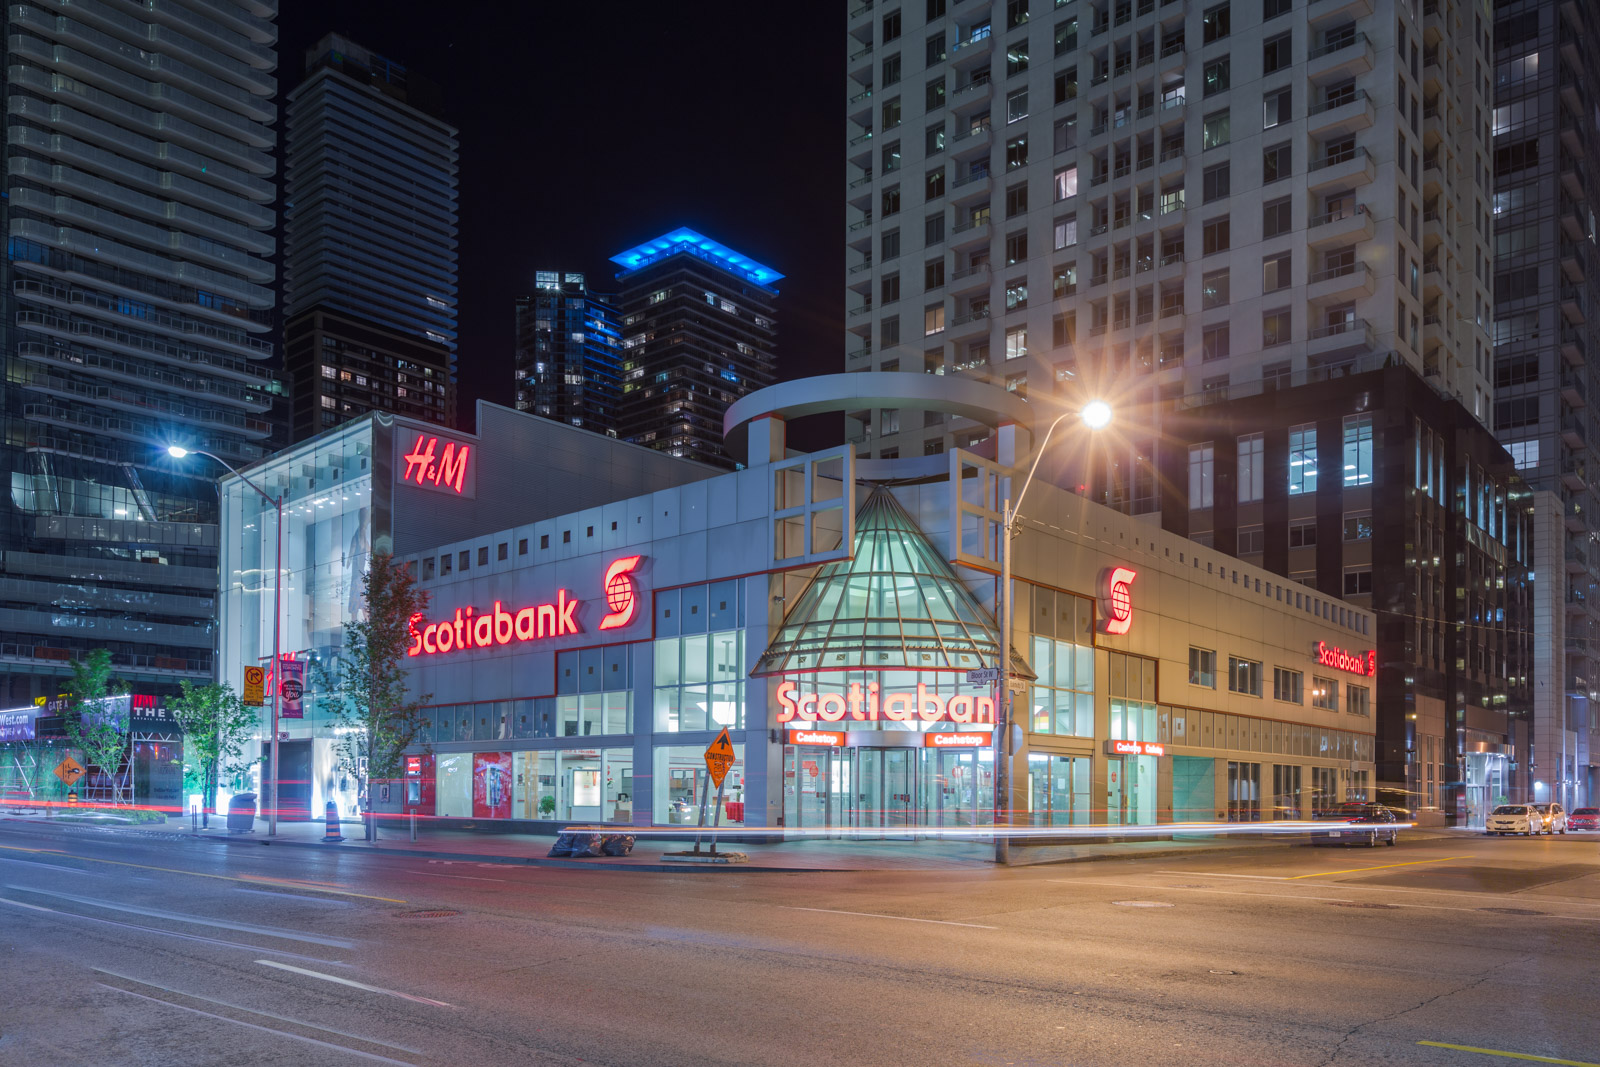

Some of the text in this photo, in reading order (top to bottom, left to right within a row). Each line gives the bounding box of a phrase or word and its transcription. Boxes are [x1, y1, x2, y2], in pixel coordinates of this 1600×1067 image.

[404, 435, 469, 493] H&M
[408, 589, 578, 657] Scotiabank
[1319, 640, 1364, 675] Scotiabank
[285, 690, 300, 701] you
[48, 700, 63, 711] GATE
[777, 682, 1000, 724] Scotiaban
[133, 707, 165, 717] THE
[796, 732, 838, 745] Cashstop
[934, 734, 983, 746] Cashstop
[706, 752, 734, 763] CONSTRUCTION
